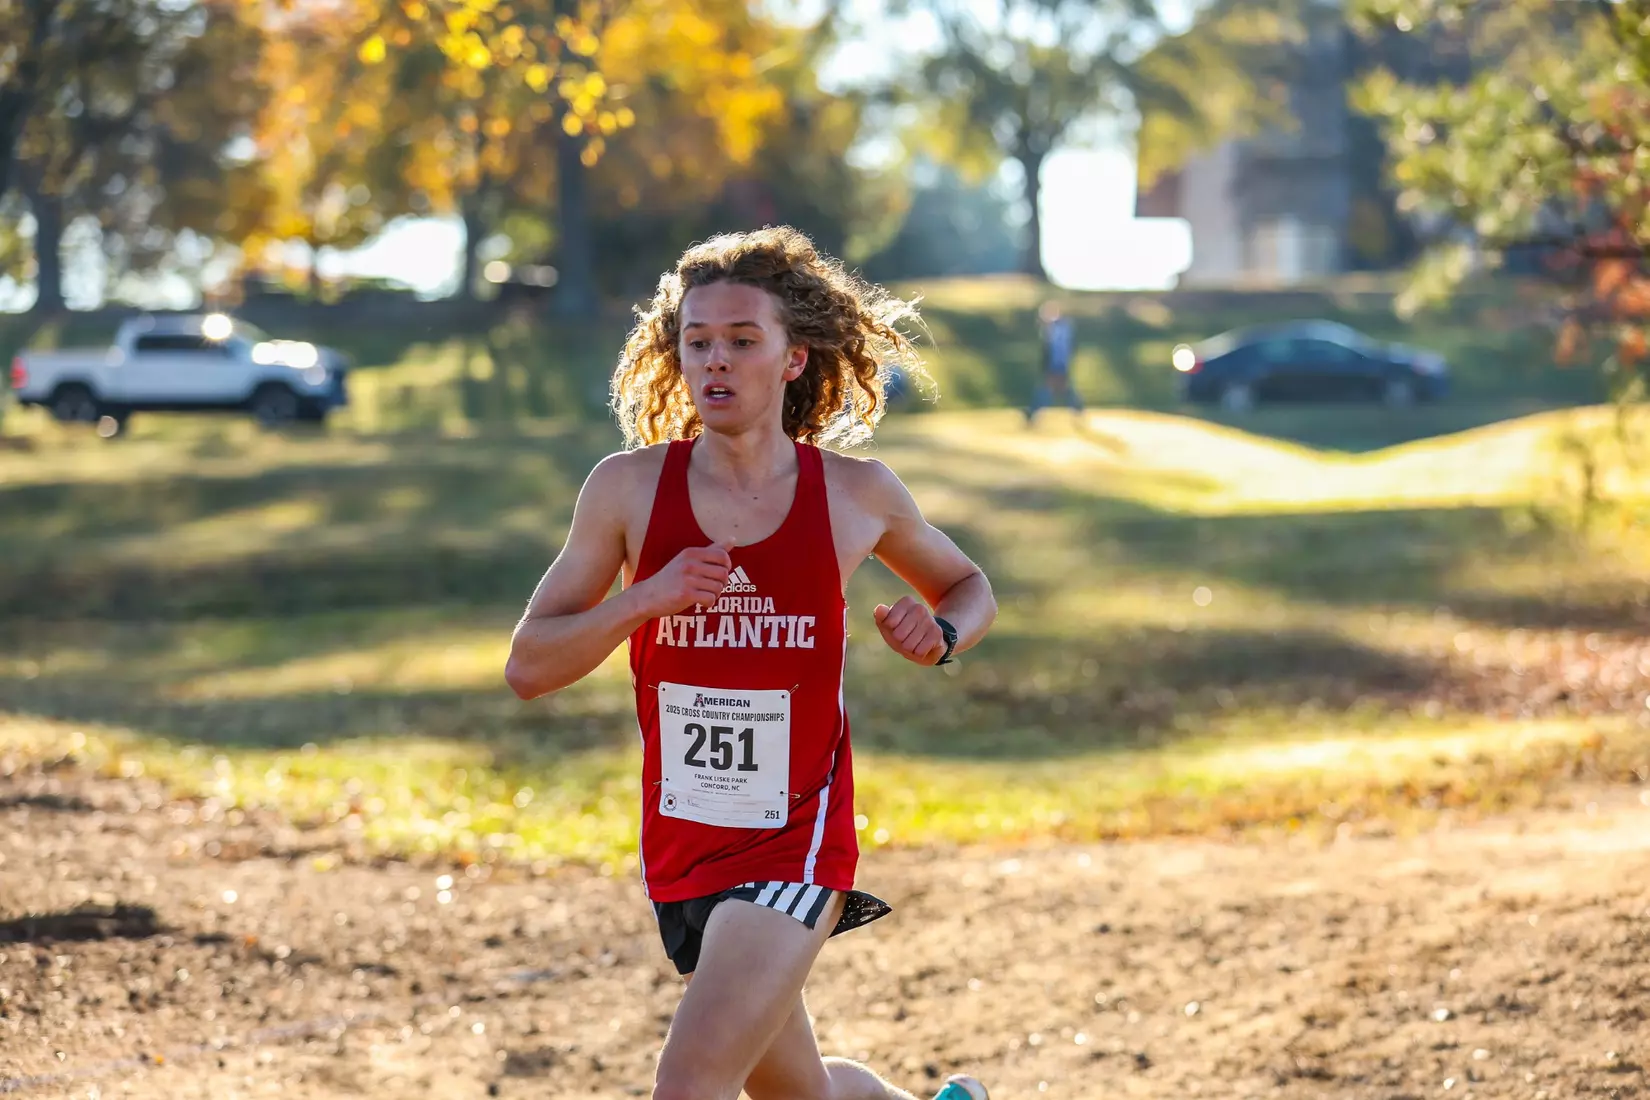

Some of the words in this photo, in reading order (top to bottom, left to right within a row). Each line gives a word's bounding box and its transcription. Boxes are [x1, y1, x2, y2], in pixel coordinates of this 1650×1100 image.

[656, 615, 816, 649] ATLANTIC
[693, 693, 750, 707] AMERICAN
[666, 704, 681, 715] 2025
[682, 707, 701, 718] CROSS
[702, 710, 730, 721] COUNTRY
[732, 712, 785, 722] CHAMPIONSHIPS
[684, 722, 758, 771] 251
[694, 773, 713, 781] FRANK
[714, 775, 730, 783] LISKE
[700, 782, 730, 791] CONCORD,
[764, 809, 780, 820] 251
